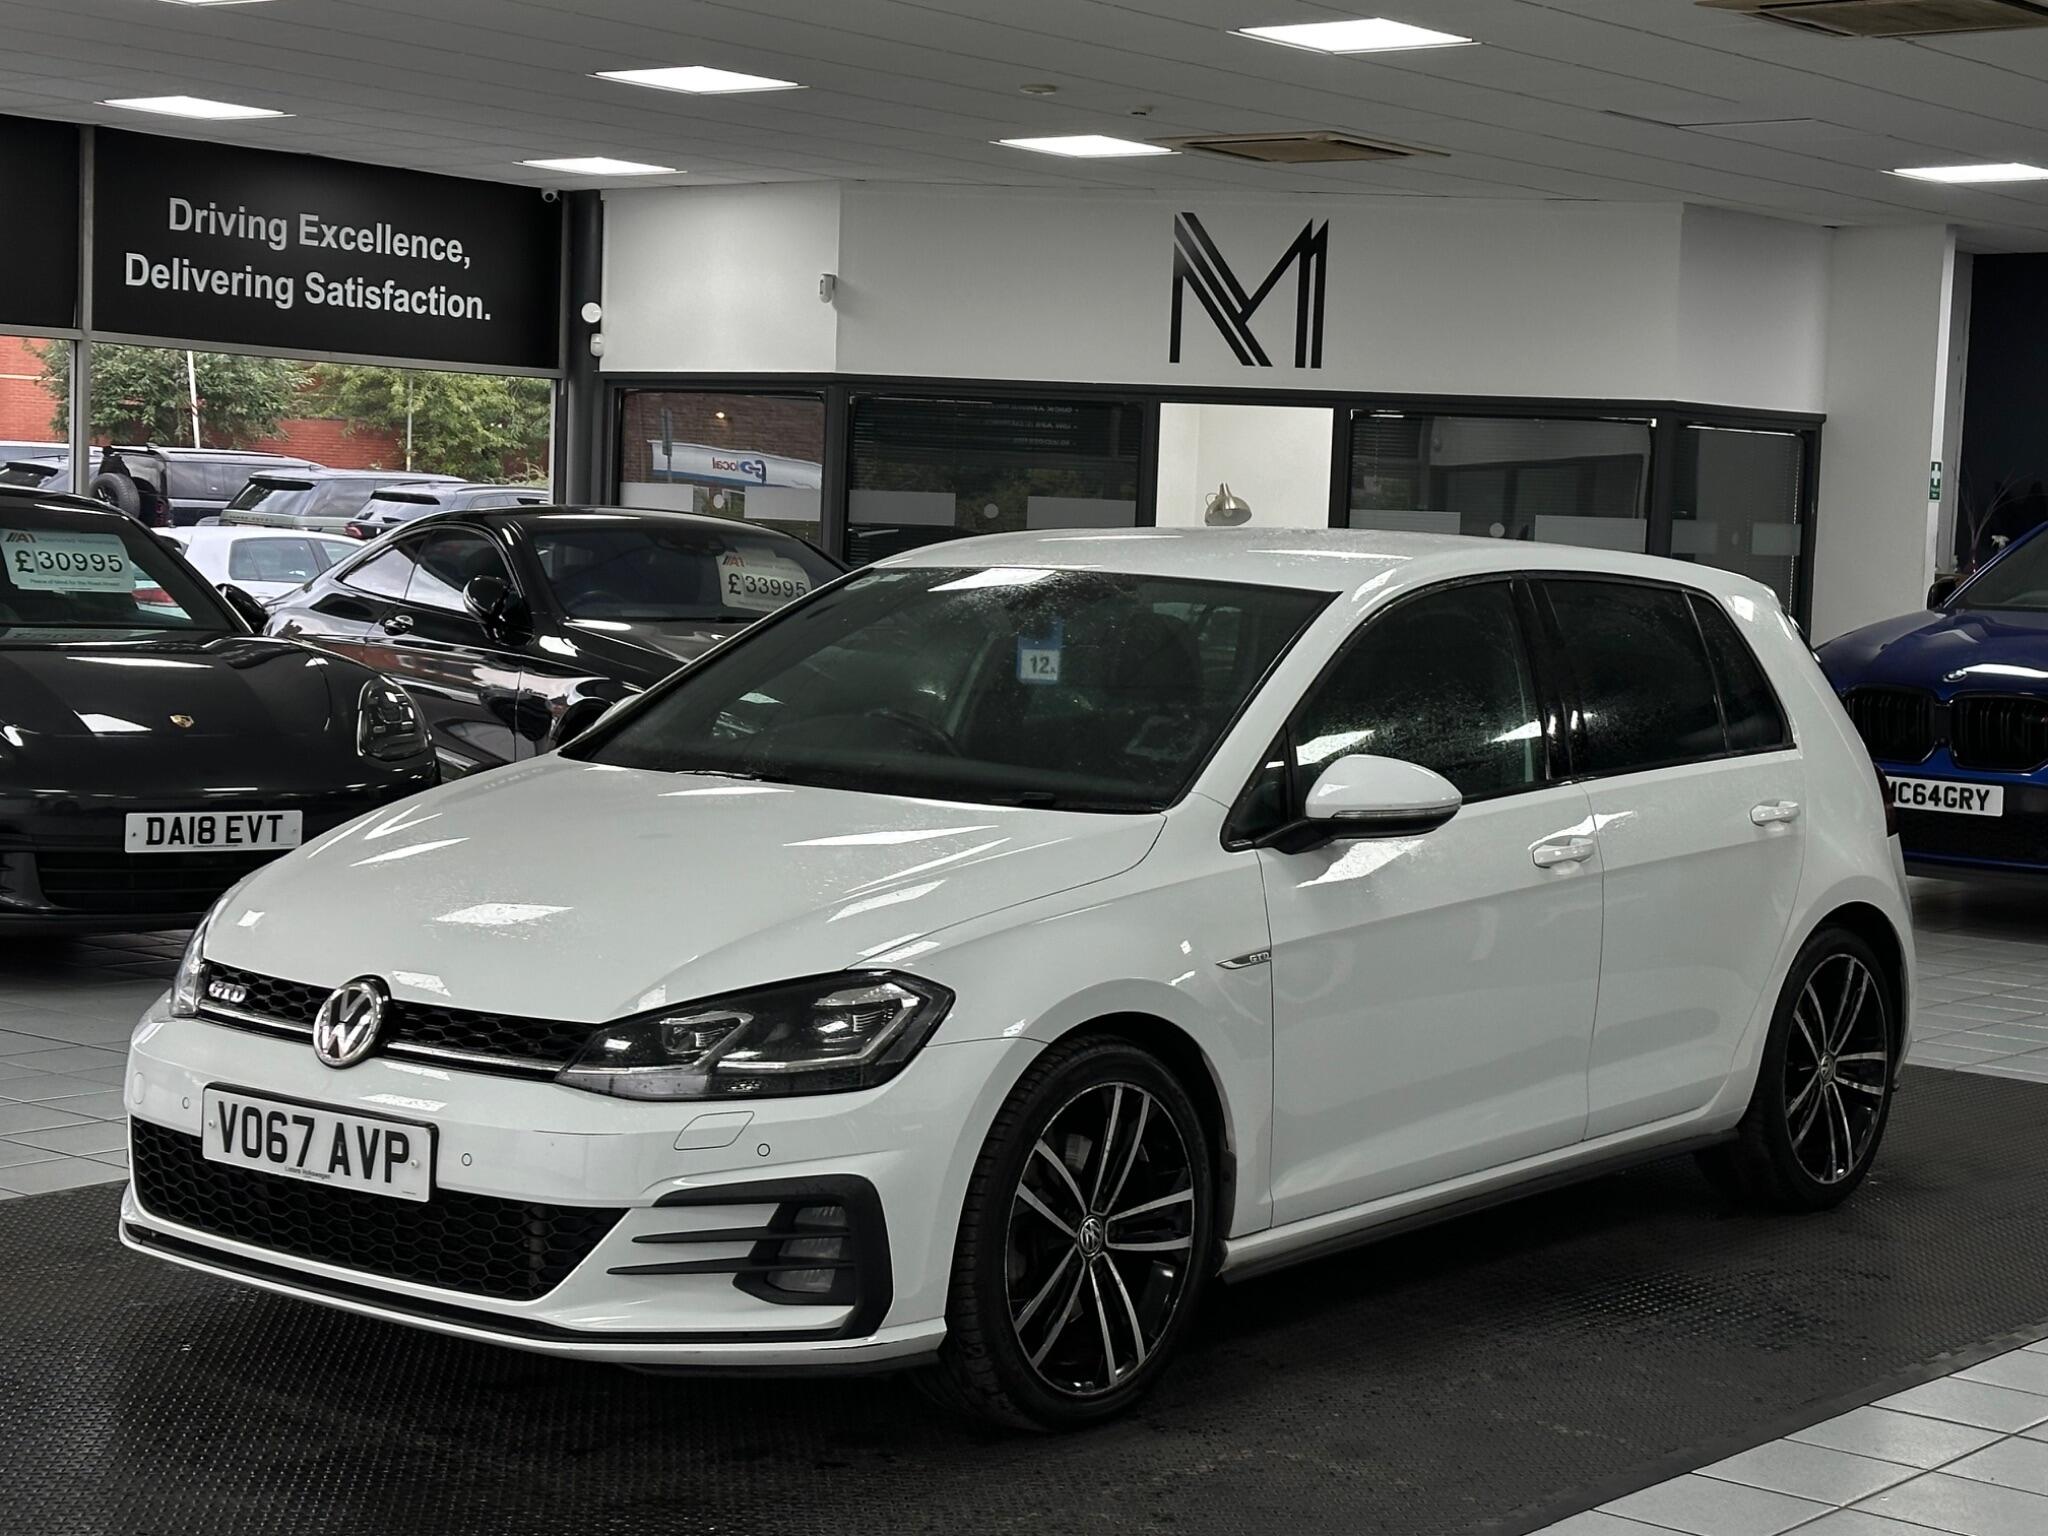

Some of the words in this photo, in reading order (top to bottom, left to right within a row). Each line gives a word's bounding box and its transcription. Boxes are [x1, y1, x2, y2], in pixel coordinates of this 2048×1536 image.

[169, 197, 287, 251] Driving
[299, 213, 471, 269] Excellence,
[125, 252, 294, 309] Delivering
[304, 271, 491, 320] Satisfaction.
[146, 816, 216, 845] DA18
[225, 815, 283, 843] EVT
[209, 980, 247, 1003] GTD
[218, 1101, 315, 1168] VO67
[328, 1122, 410, 1183] AVP
